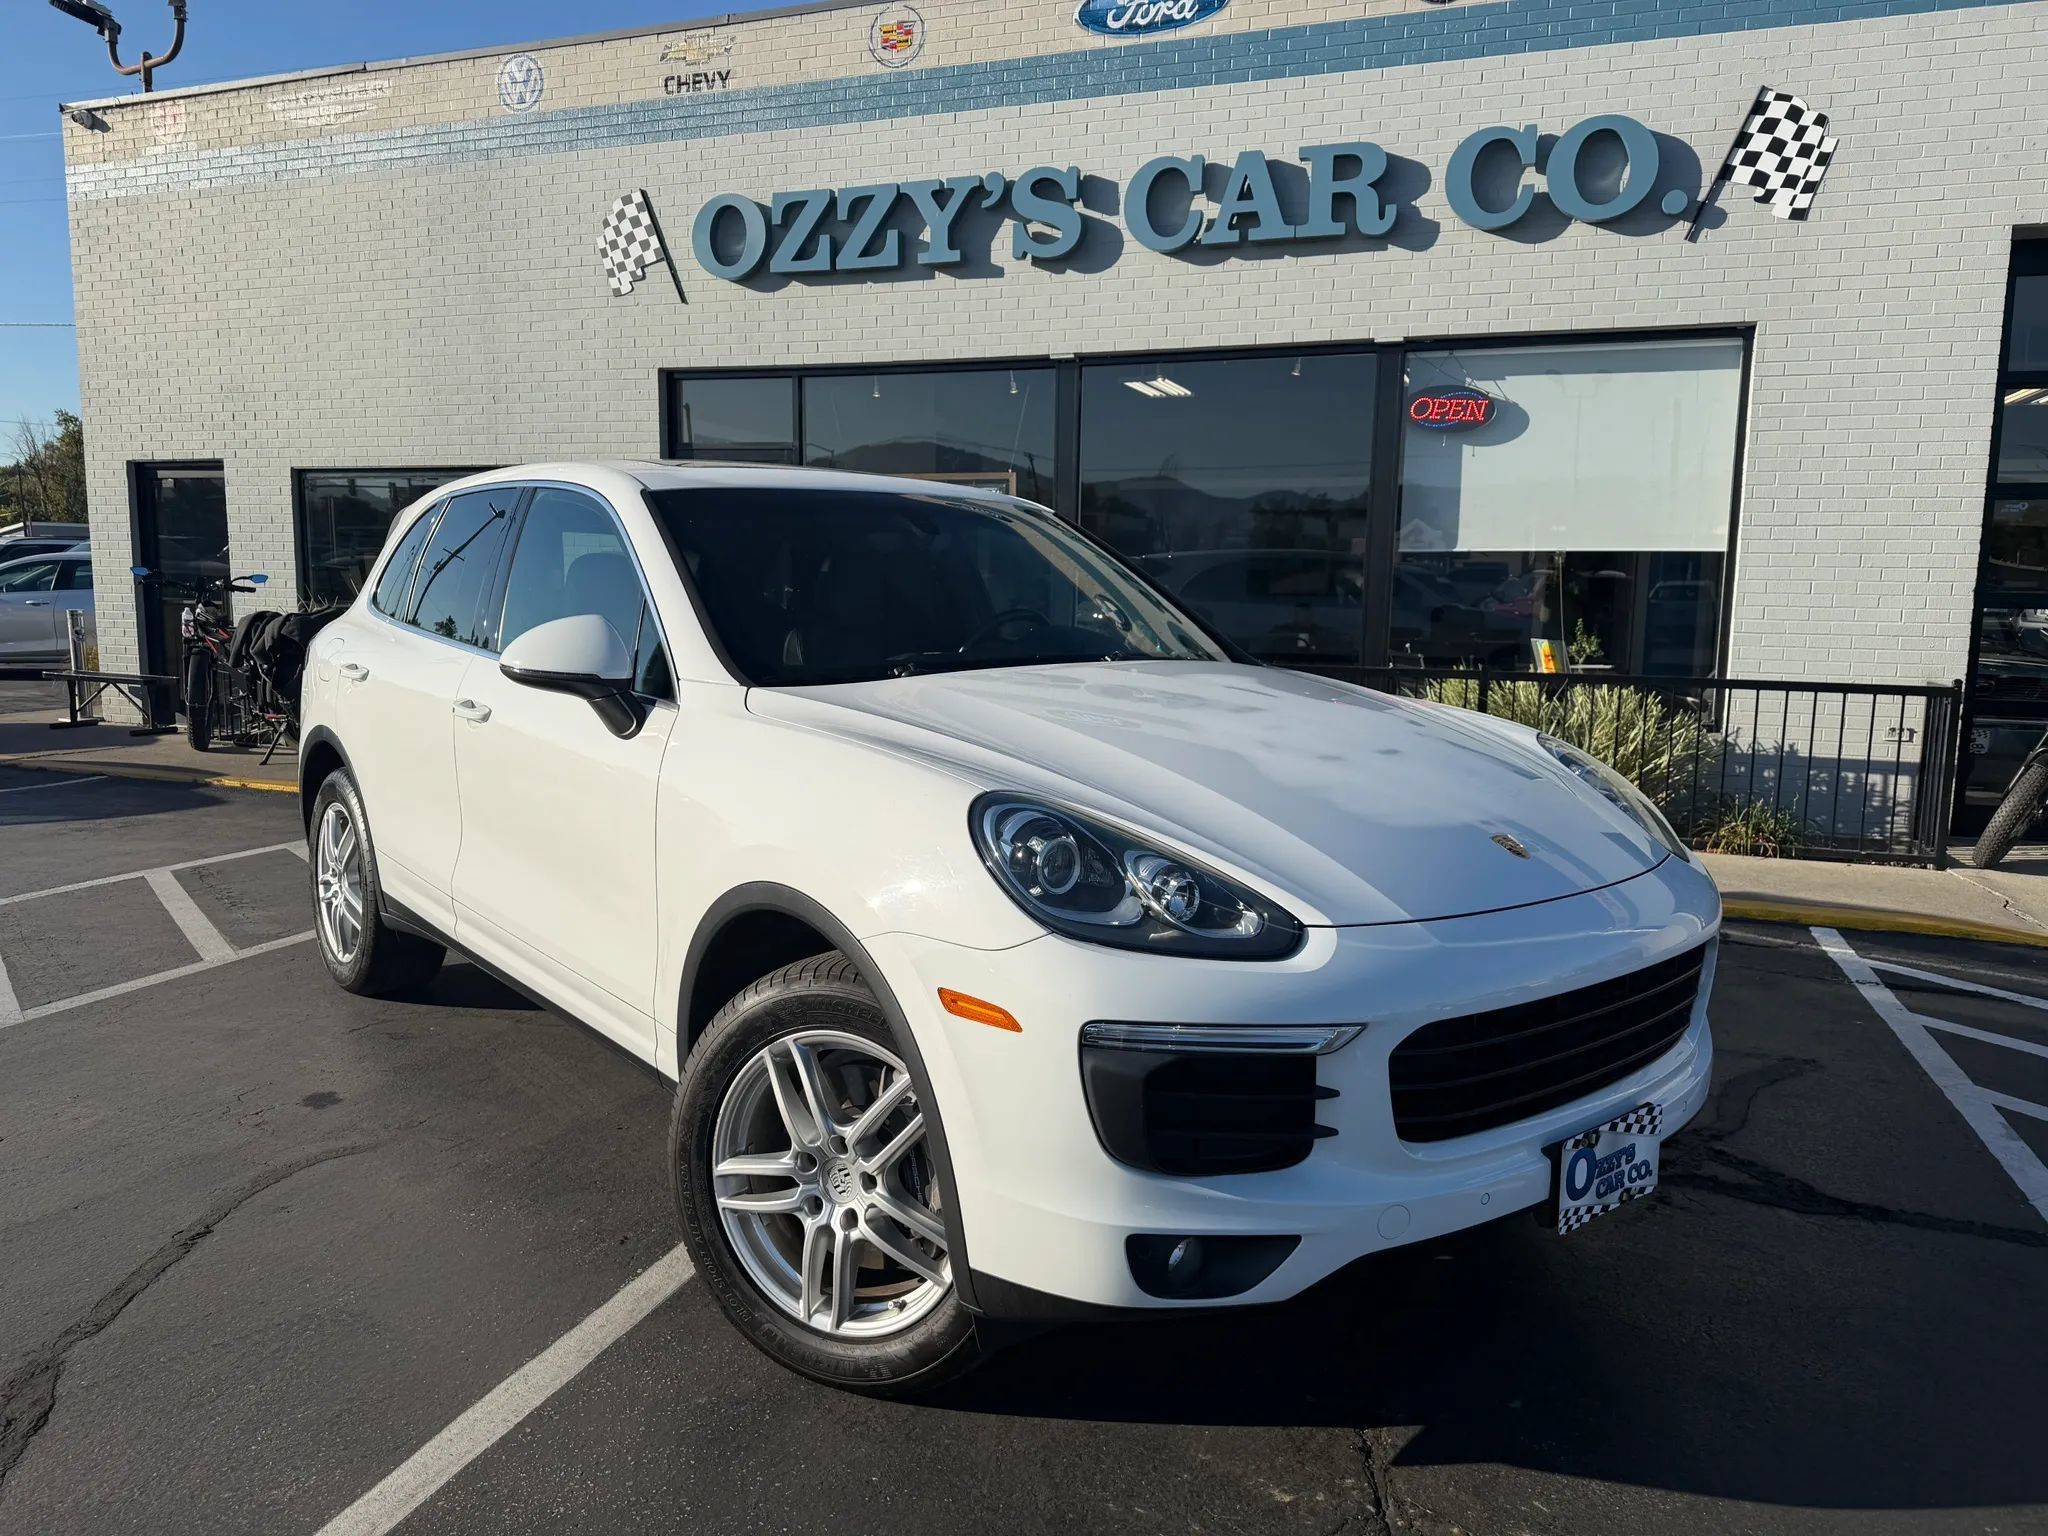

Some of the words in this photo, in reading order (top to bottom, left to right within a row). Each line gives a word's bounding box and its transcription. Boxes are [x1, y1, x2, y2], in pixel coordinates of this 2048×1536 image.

[664, 69, 732, 95] CHEVY
[692, 166, 1084, 280] OZZY'S
[1123, 141, 1398, 253] CAR
[1445, 114, 1688, 230] CO.
[1409, 397, 1489, 421] OPEN
[1595, 1169, 1626, 1200] CAR
